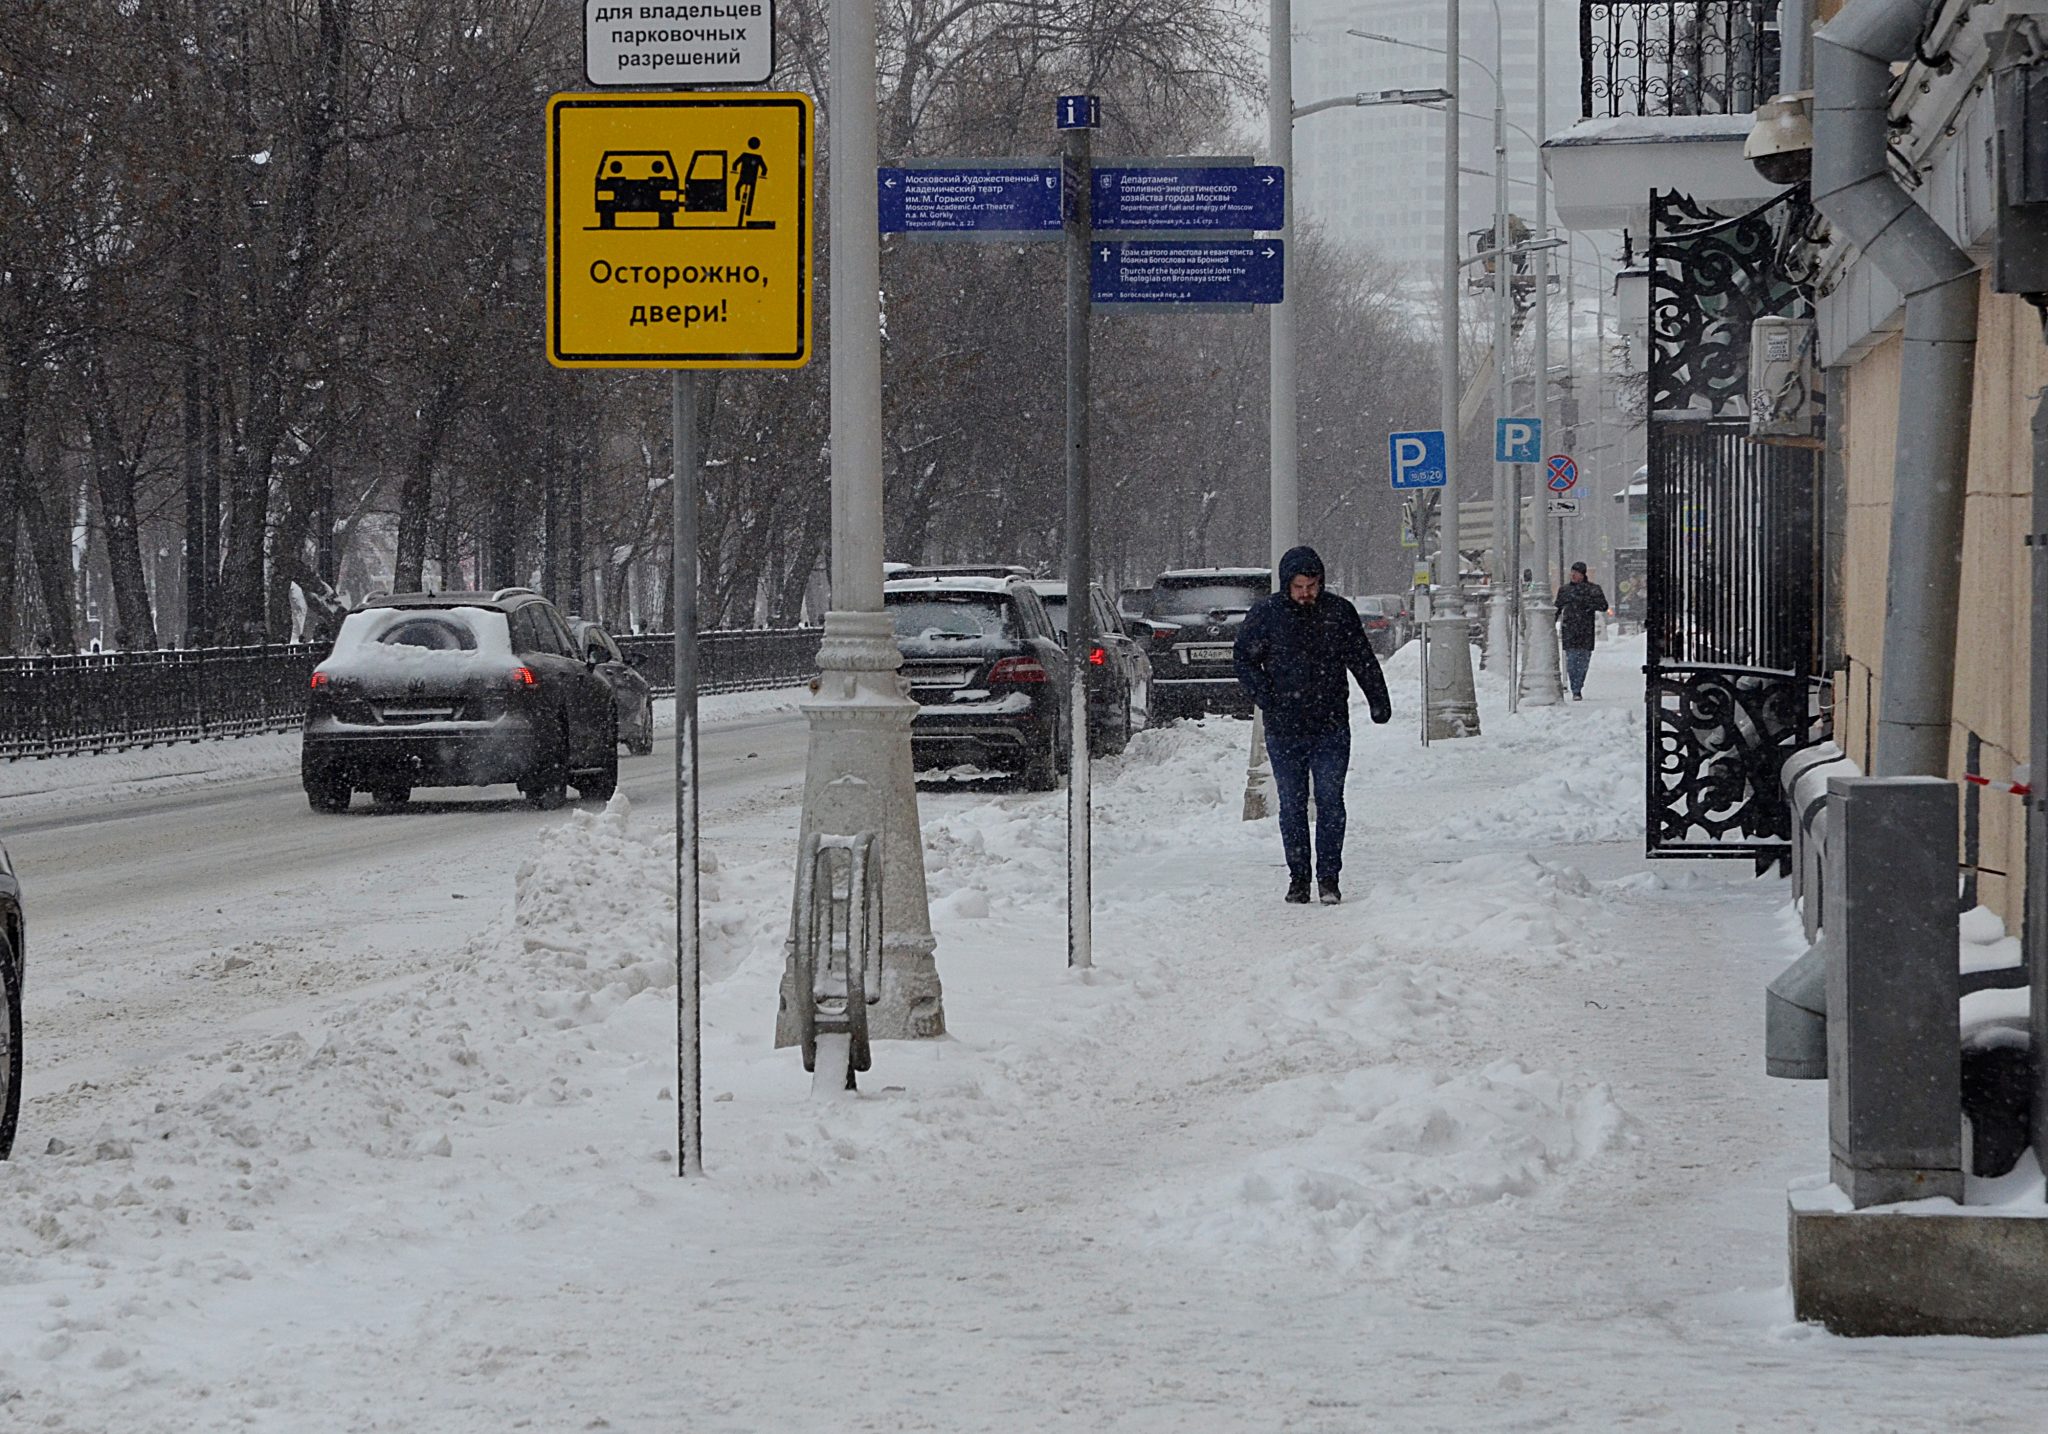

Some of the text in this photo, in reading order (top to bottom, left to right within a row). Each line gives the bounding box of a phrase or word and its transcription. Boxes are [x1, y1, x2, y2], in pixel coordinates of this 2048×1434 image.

[596, 4, 762, 22] для владельцев
[612, 28, 746, 46] парковочных
[618, 48, 740, 69] разрешений
[905, 174, 1039, 184] Московский Художественный
[1120, 175, 1178, 185] Департамент
[905, 185, 1003, 194] Академический театр
[1120, 185, 1238, 194] топливно-энергетического
[923, 195, 932, 203] М.
[934, 195, 975, 205] Горького
[1120, 193, 1230, 203] хозяйства города Москвы
[1120, 204, 1159, 212] Department
[1195, 204, 1219, 213] energy
[929, 211, 953, 219] Gorkiy
[906, 220, 935, 228] Тверской
[1148, 218, 1174, 226] Бронная
[1120, 249, 1140, 257] Храм
[1120, 256, 1148, 264] Иоанна
[1149, 256, 1186, 264] Богослова
[1197, 256, 1229, 265] Бронной
[590, 259, 768, 289] Осторожно,
[1147, 267, 1155, 275] of
[1169, 267, 1186, 276] holy
[1186, 267, 1214, 276] apostle
[1214, 267, 1232, 275] John
[1120, 275, 1161, 284] Theologian
[1172, 275, 1207, 284] Bronnaya
[630, 298, 727, 328] двери!
[1504, 423, 1532, 457] P
[1395, 438, 1427, 483] P
[1430, 470, 1441, 480] 20
